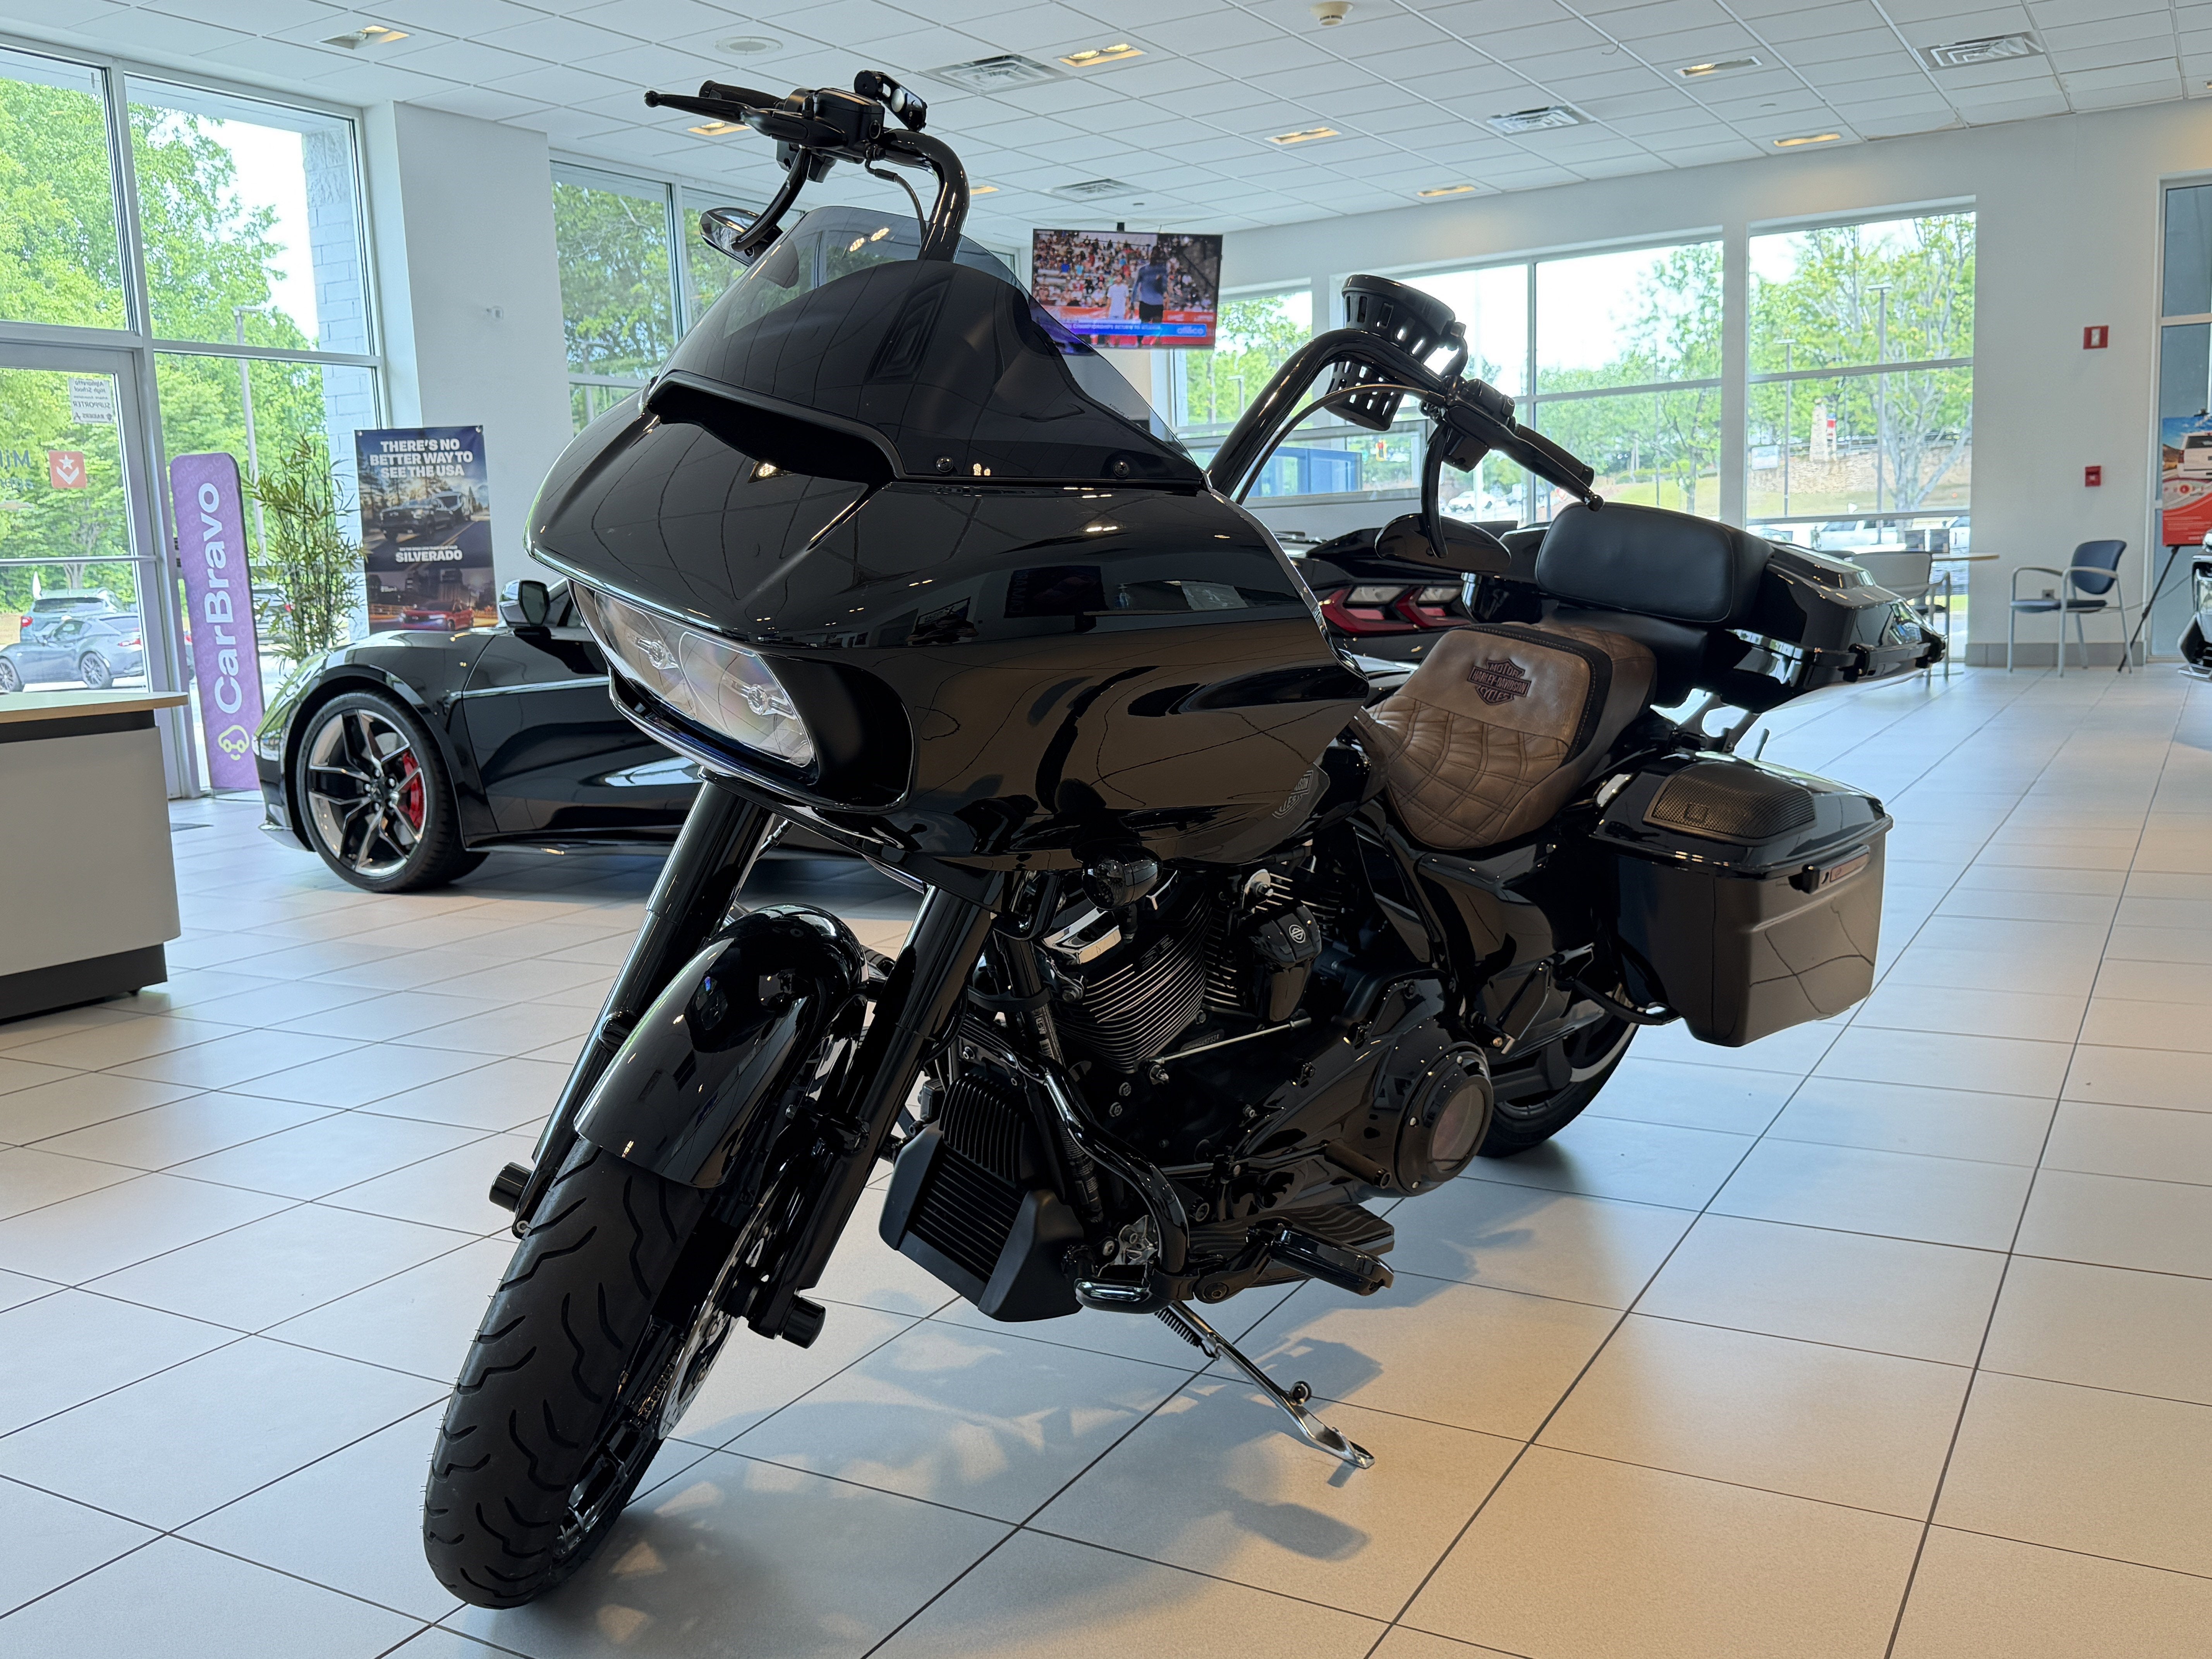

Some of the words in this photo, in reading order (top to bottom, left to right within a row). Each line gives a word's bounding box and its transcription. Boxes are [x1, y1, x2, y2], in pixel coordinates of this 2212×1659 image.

[380, 439, 438, 452] THERE'S
[440, 438, 460, 450] NO
[370, 453, 422, 466] BETTER
[422, 452, 454, 464] WAY
[455, 451, 473, 463] TO
[380, 467, 407, 478] SEE
[407, 465, 435, 477] THE
[436, 464, 465, 477] USA
[395, 550, 463, 563] SILVERADO
[198, 483, 242, 714] CarBravo
[1489, 663, 1519, 677] MOTOR
[1472, 670, 1527, 693] HARLEY-DAVIDSON
[1480, 686, 1510, 701] CYCLES
